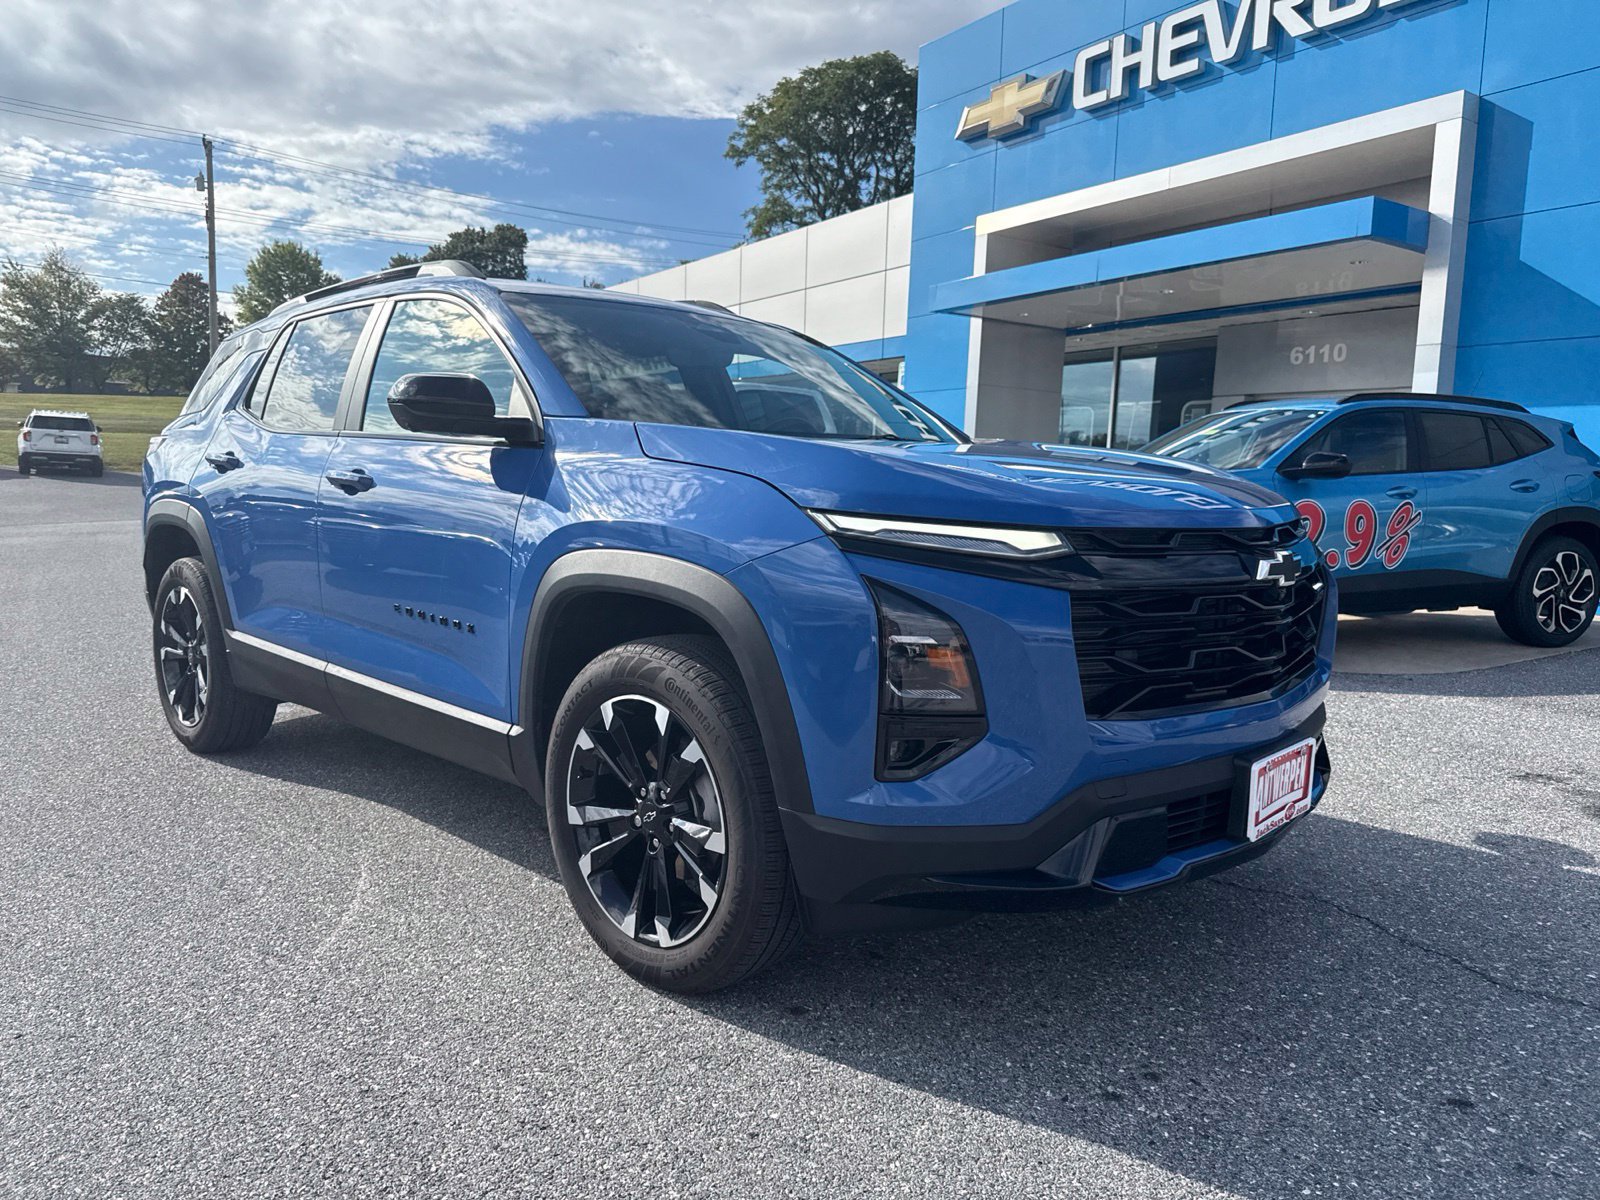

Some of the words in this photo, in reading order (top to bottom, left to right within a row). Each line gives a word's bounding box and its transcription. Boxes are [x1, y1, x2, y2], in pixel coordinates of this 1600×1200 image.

[1073, 0, 1408, 111] CHEVR
[1290, 343, 1347, 365] 6110
[664, 677, 716, 735] Continental
[1256, 754, 1307, 812] ANTWERPEN
